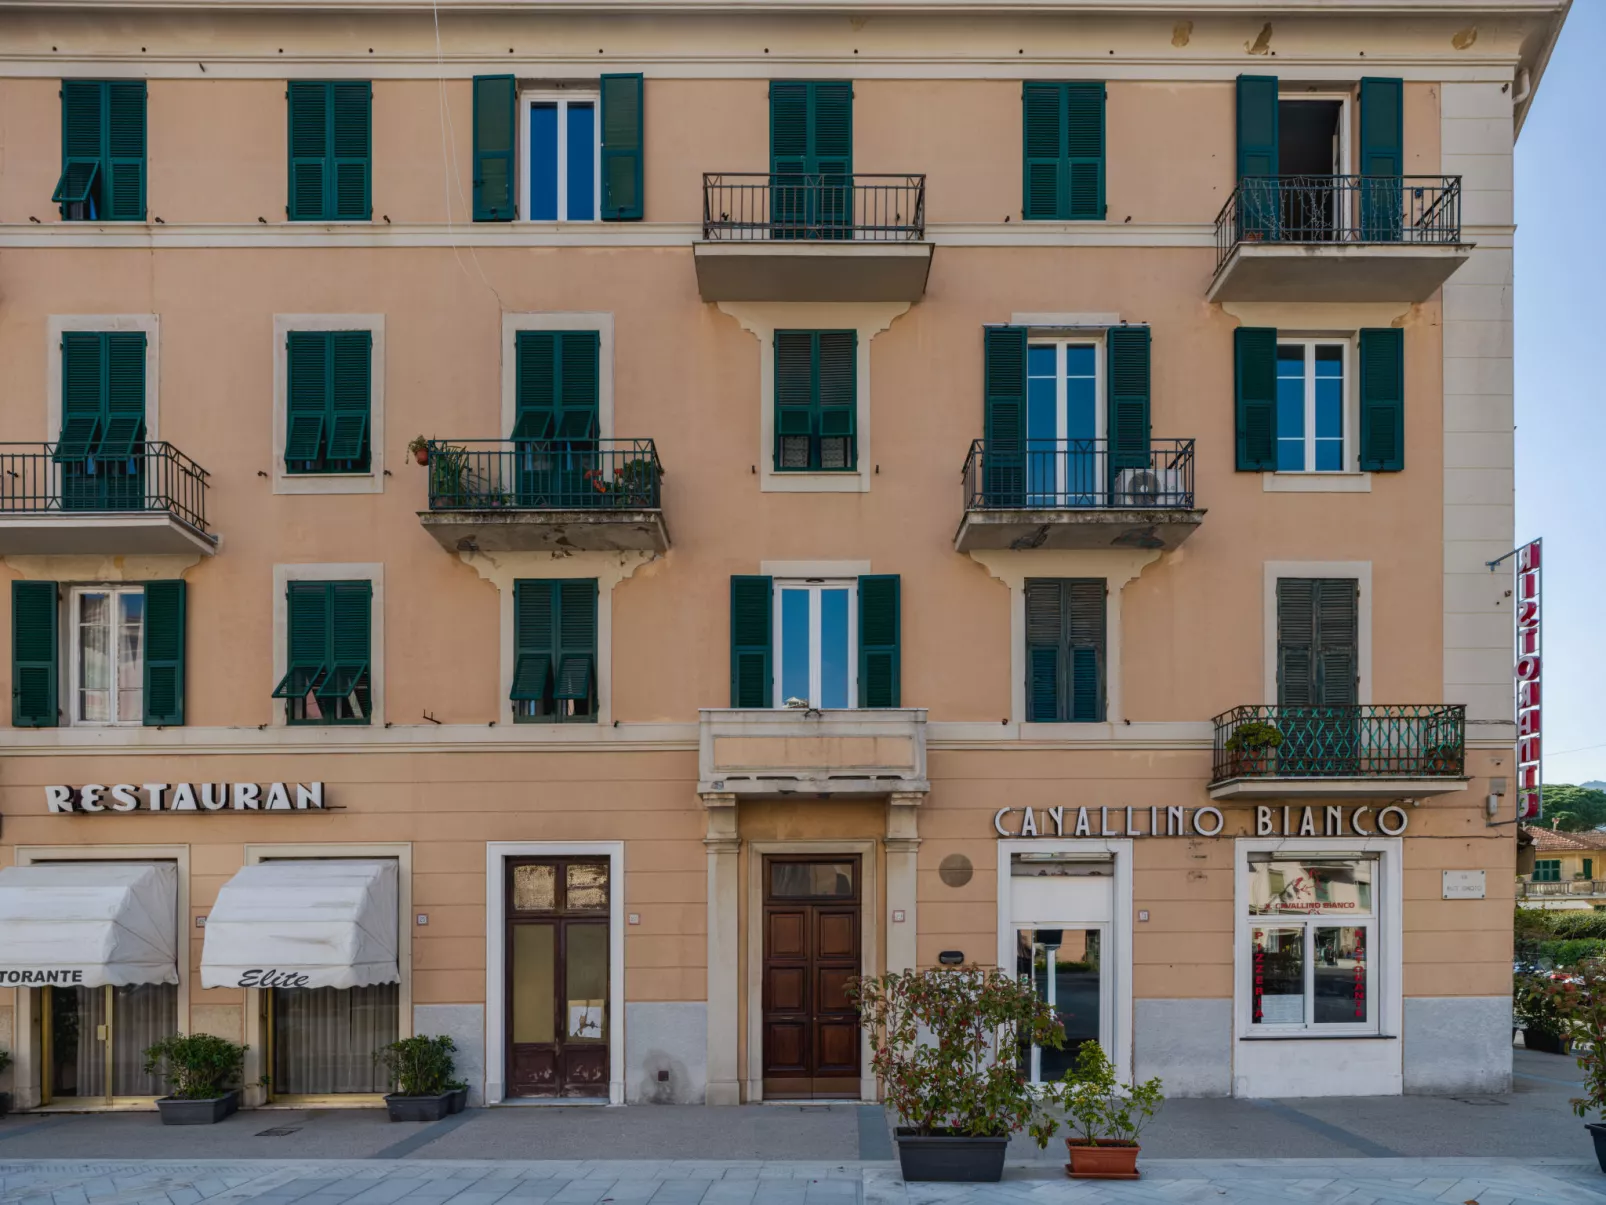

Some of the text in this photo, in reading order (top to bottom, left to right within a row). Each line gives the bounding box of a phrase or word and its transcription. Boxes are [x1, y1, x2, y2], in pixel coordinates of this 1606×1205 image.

[45, 782, 325, 813] RESTAURAN
[994, 805, 1409, 837] CAVALLINO BIANCO
[237, 968, 309, 988] Elite
[1255, 931, 1264, 1018] PIZZERIA
[1354, 929, 1364, 1017] RISTORANTE
